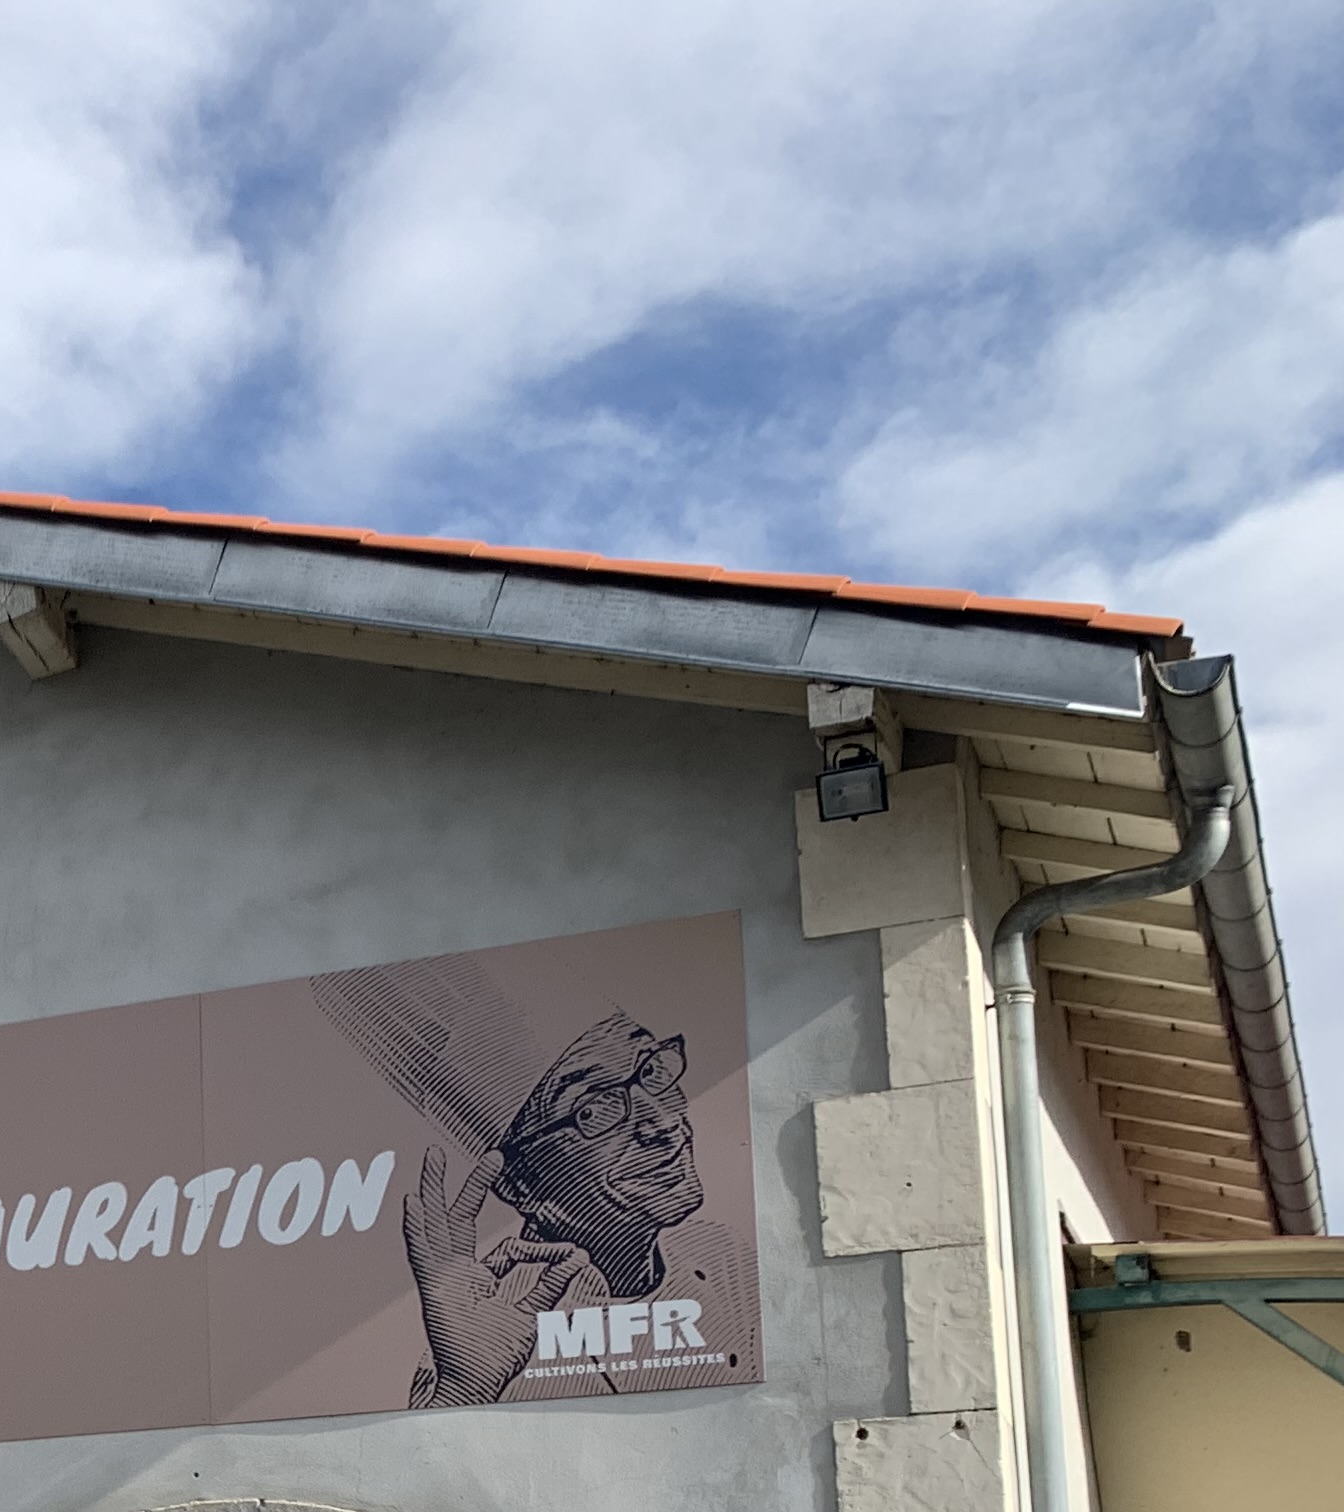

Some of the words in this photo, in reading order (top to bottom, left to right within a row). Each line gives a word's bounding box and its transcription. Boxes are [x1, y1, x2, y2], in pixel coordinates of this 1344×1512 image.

[537, 1299, 707, 1360] MFR
[524, 1363, 606, 1379] CULTIVONS
[612, 1360, 637, 1372] LES
[643, 1353, 725, 1370] RÉUSSITES
